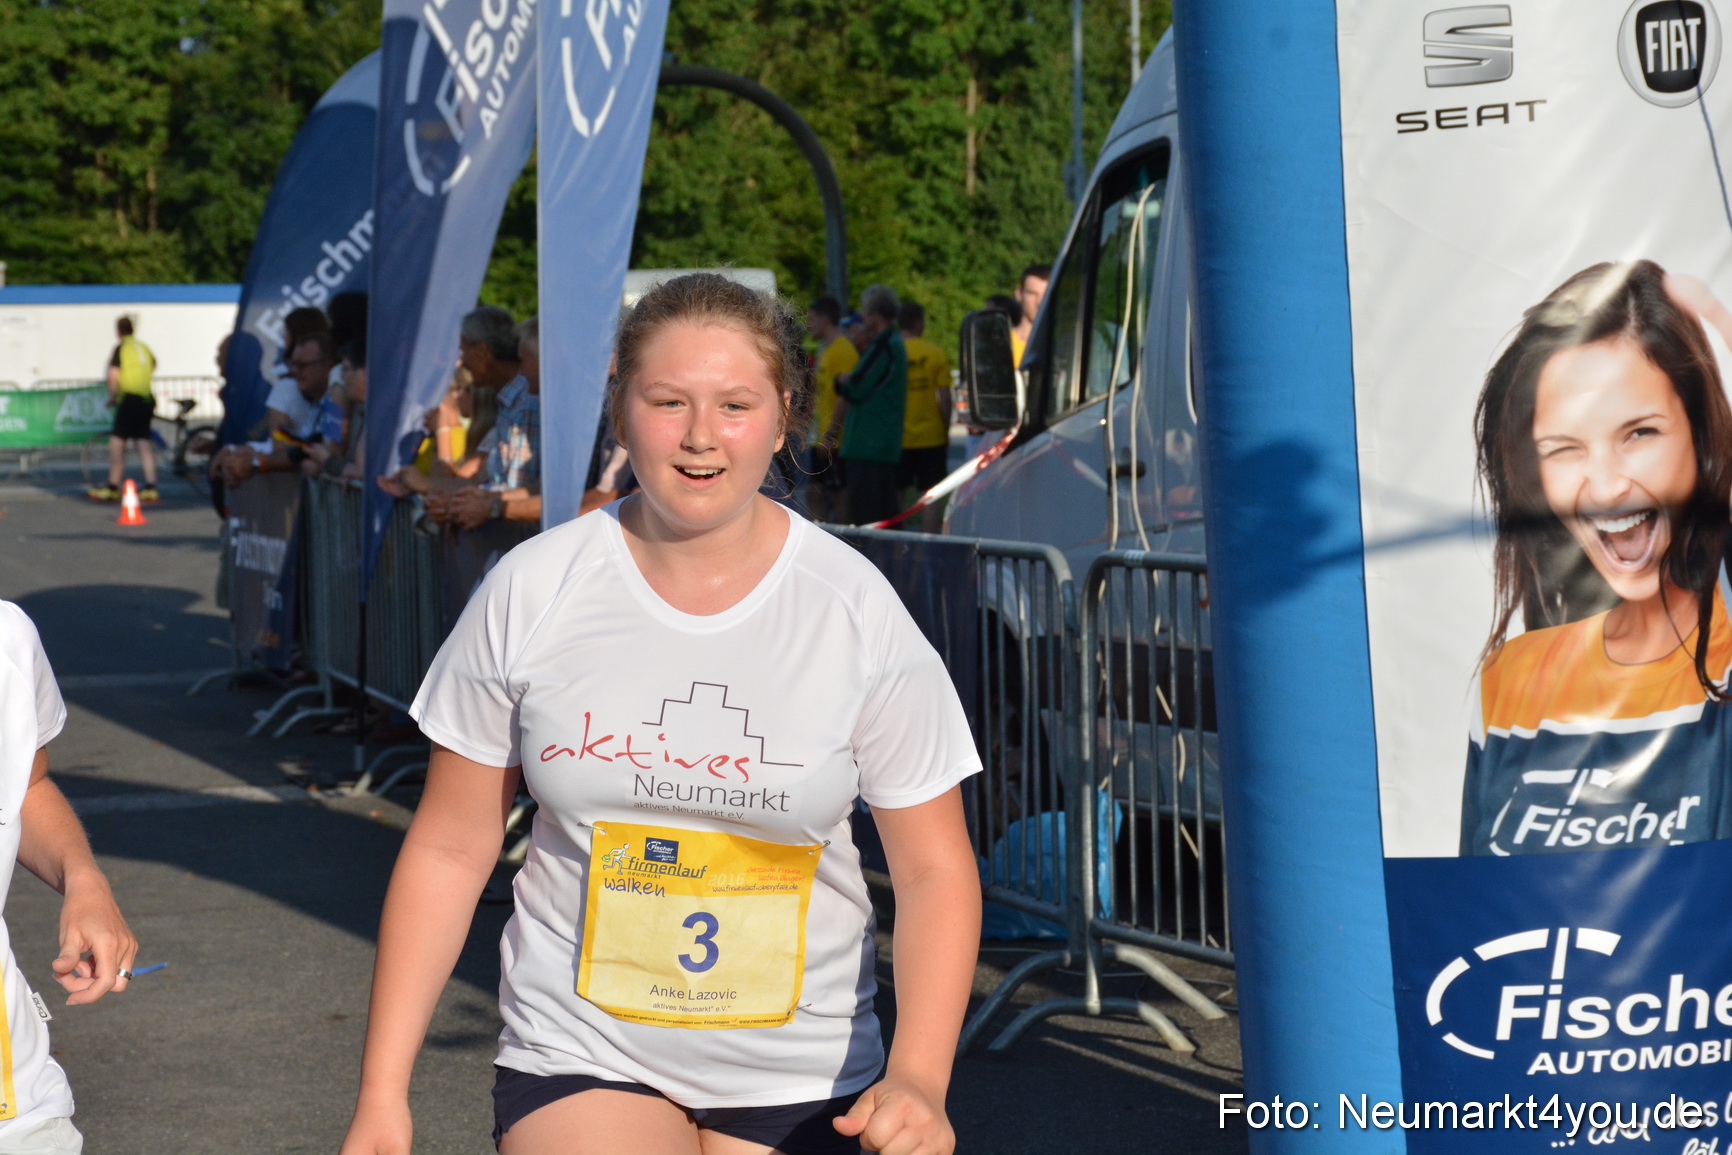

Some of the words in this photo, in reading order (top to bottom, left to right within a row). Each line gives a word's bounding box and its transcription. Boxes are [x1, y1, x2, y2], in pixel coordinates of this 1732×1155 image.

[1645, 18, 1702, 74] FIAT
[479, 0, 537, 139] AUTOM
[1396, 99, 1547, 134] SEAT
[540, 711, 750, 783] aktives
[633, 774, 791, 812] Neumarkt
[633, 802, 670, 812] aktives
[672, 805, 725, 818] Neumarkt
[727, 810, 745, 820] e.V.
[1513, 795, 1701, 847] Fischer
[626, 871, 662, 880] neumarkt
[628, 857, 708, 879] firmenlauf
[708, 872, 746, 887] 2016
[604, 877, 665, 898] walken
[677, 911, 720, 974] 3
[650, 984, 685, 999] Anke
[688, 988, 738, 1001] Lazovic
[652, 1002, 677, 1011] aktives
[1526, 1038, 1732, 1076] AUTOMOBI
